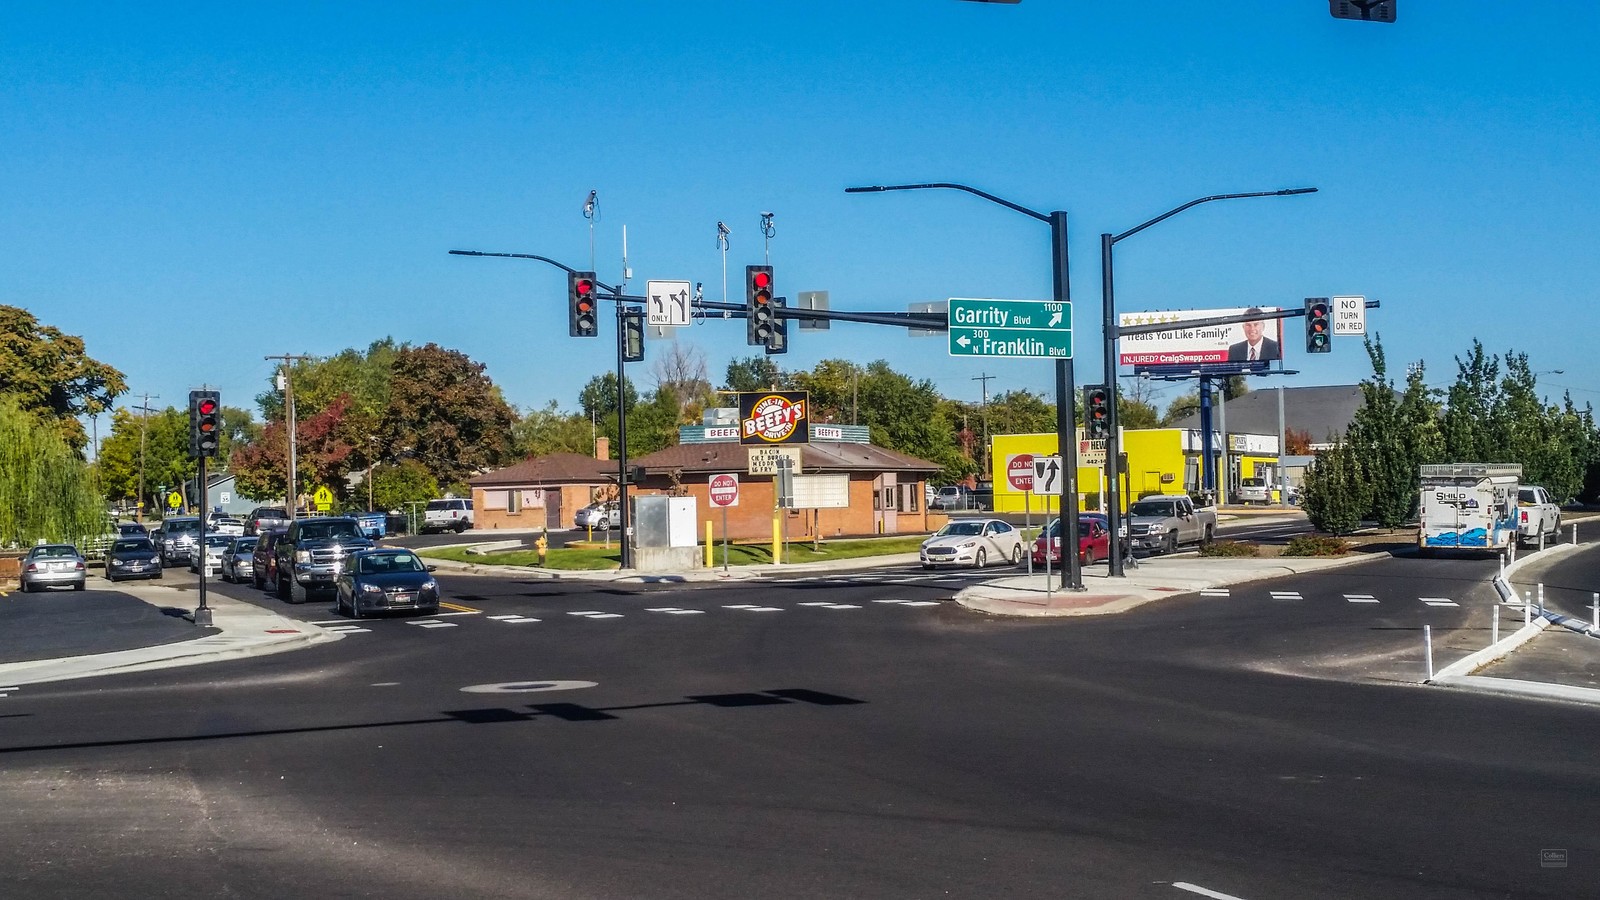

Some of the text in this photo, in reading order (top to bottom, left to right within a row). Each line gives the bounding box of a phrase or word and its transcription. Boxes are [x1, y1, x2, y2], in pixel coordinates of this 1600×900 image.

[1044, 303, 1063, 312] 1100
[1341, 300, 1356, 309] NO
[955, 306, 1031, 327] Garrity Blvd
[1336, 322, 1362, 330] ON RED
[973, 330, 989, 338] 300
[1156, 331, 1173, 340] You
[1175, 330, 1193, 339] Like
[973, 338, 1066, 356] N Franklin Blvd
[1123, 353, 1221, 363] INJURED? CraigSwapp.com
[755, 398, 784, 414] DINE-IN
[744, 403, 802, 435] BEEFY'S
[710, 429, 739, 437] BEEFY
[763, 422, 793, 439] DRIVE-IN
[1025, 460, 1033, 468] NO
[1436, 492, 1466, 501] SHILO
